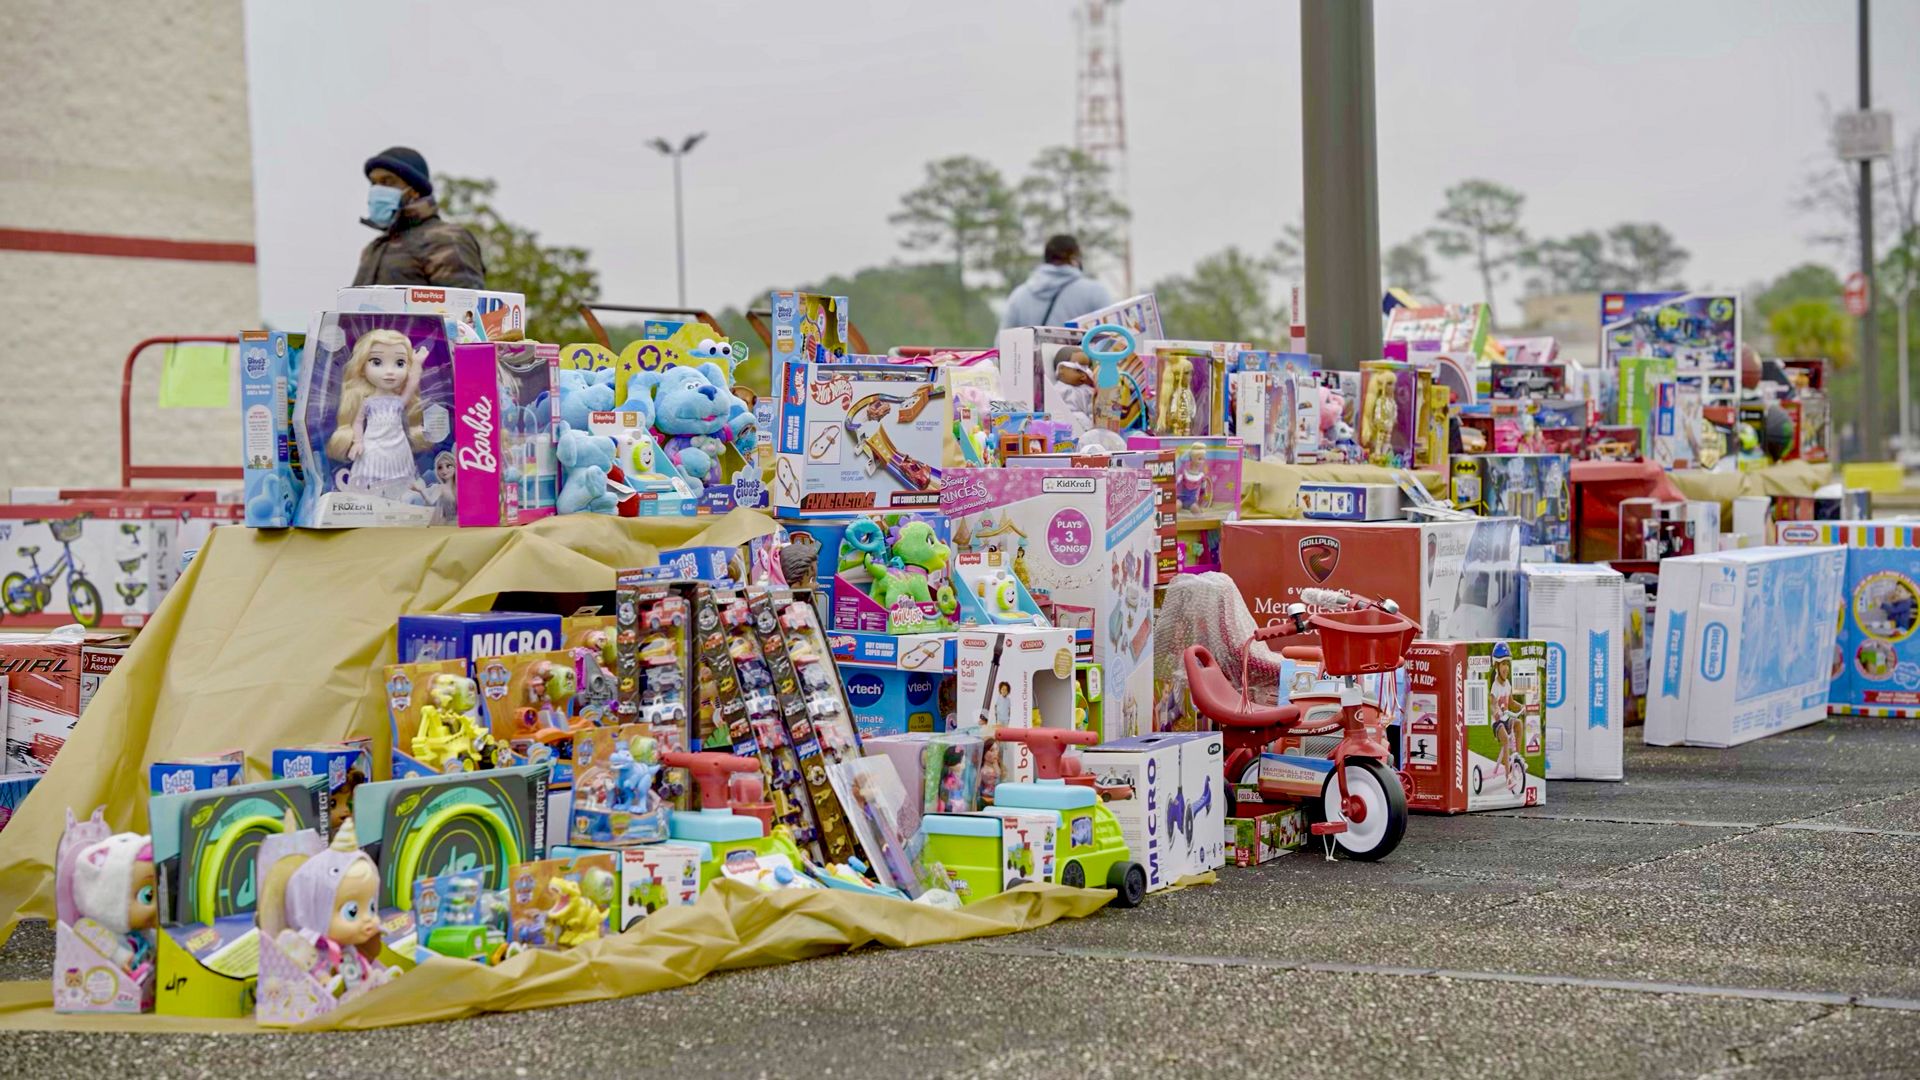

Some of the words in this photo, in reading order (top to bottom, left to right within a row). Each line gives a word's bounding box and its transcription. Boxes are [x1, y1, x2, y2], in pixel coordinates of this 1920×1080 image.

[413, 291, 444, 300] Fisher-Price
[459, 396, 497, 472] Barbie
[736, 478, 760, 488] Blue's
[1056, 479, 1092, 488] KidKraft
[940, 480, 988, 503] RINCESS
[333, 502, 366, 511] FROZEN
[1057, 521, 1082, 529] PLAYS
[1065, 531, 1074, 543] 3
[1301, 539, 1340, 548] ROLLPLAY
[1055, 545, 1086, 553] SONGS
[1287, 587, 1294, 595] 6
[472, 629, 554, 662] MICRO
[1022, 641, 1044, 649] CASDON
[0, 658, 73, 673] HIRL
[91, 655, 108, 666] Easy
[108, 656, 116, 664] to
[961, 658, 983, 668] dyson
[1593, 648, 1604, 679] Slide
[90, 663, 114, 671] Assem
[1415, 660, 1430, 672] YOU
[961, 670, 975, 678] ball
[1413, 674, 1419, 684] A
[847, 683, 882, 695] vtech
[908, 681, 932, 693] vtech
[1594, 682, 1604, 707] First
[855, 713, 885, 723] timate
[917, 715, 925, 723] 10
[1017, 743, 1028, 769] bal
[283, 755, 312, 776] baby
[1262, 766, 1299, 775] MARSHALL
[1300, 769, 1316, 777] FIRE
[1263, 771, 1285, 779] TRUCK
[1286, 773, 1315, 781] RIDE-ON
[318, 791, 329, 849] EPERFECT
[1147, 757, 1160, 886] MICRO
